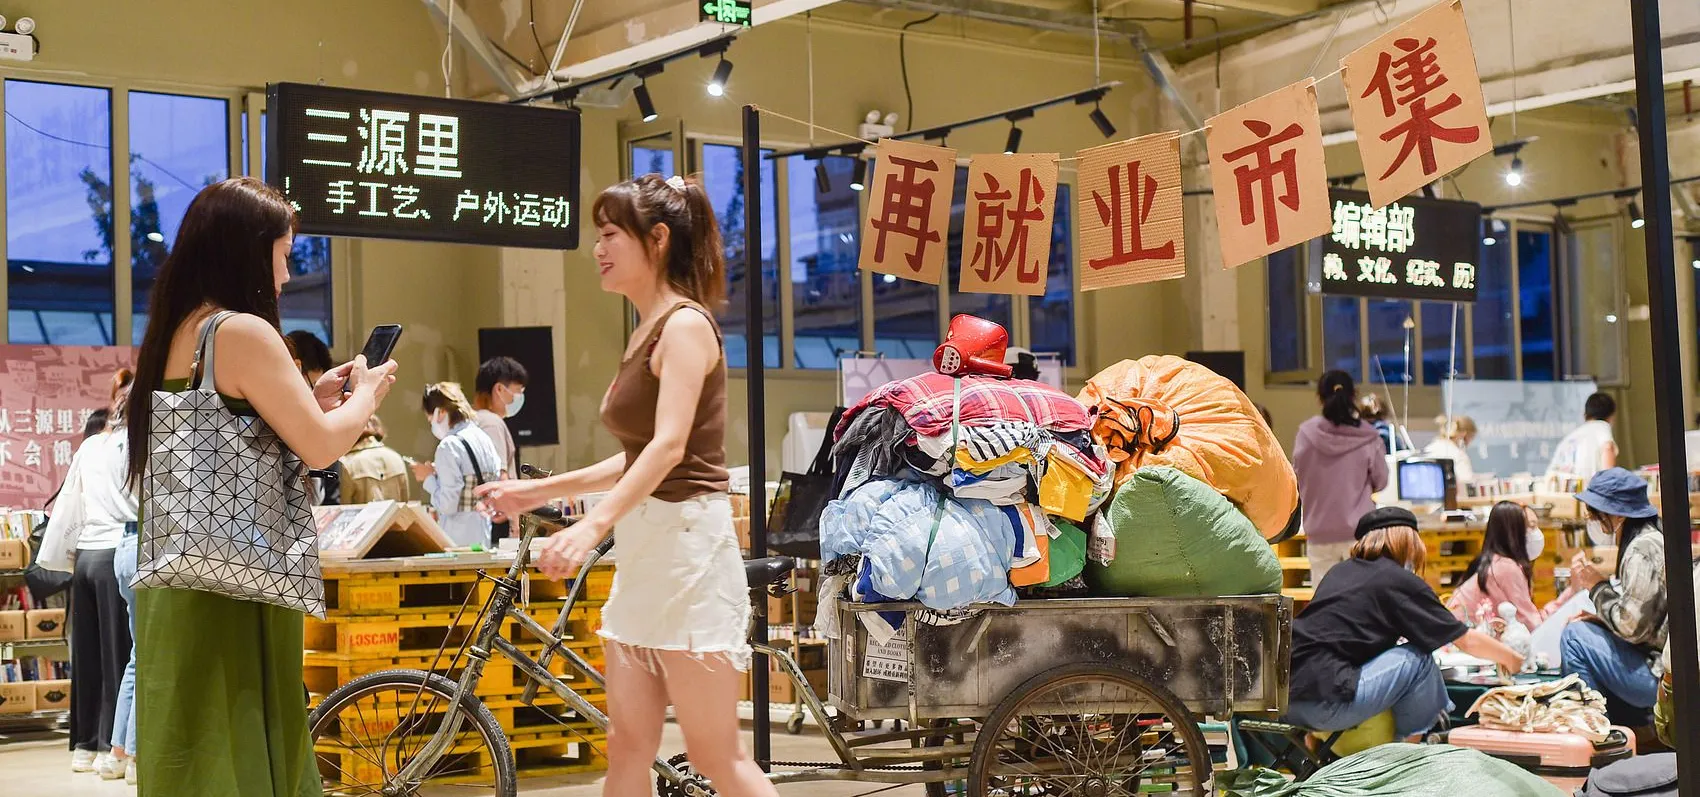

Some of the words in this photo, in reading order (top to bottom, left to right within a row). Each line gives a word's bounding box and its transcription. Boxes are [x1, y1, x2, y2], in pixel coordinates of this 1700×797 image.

[302, 108, 462, 178] 三源里
[1332, 200, 1415, 253] 编辑部
[350, 632, 397, 647] LOSCAM
